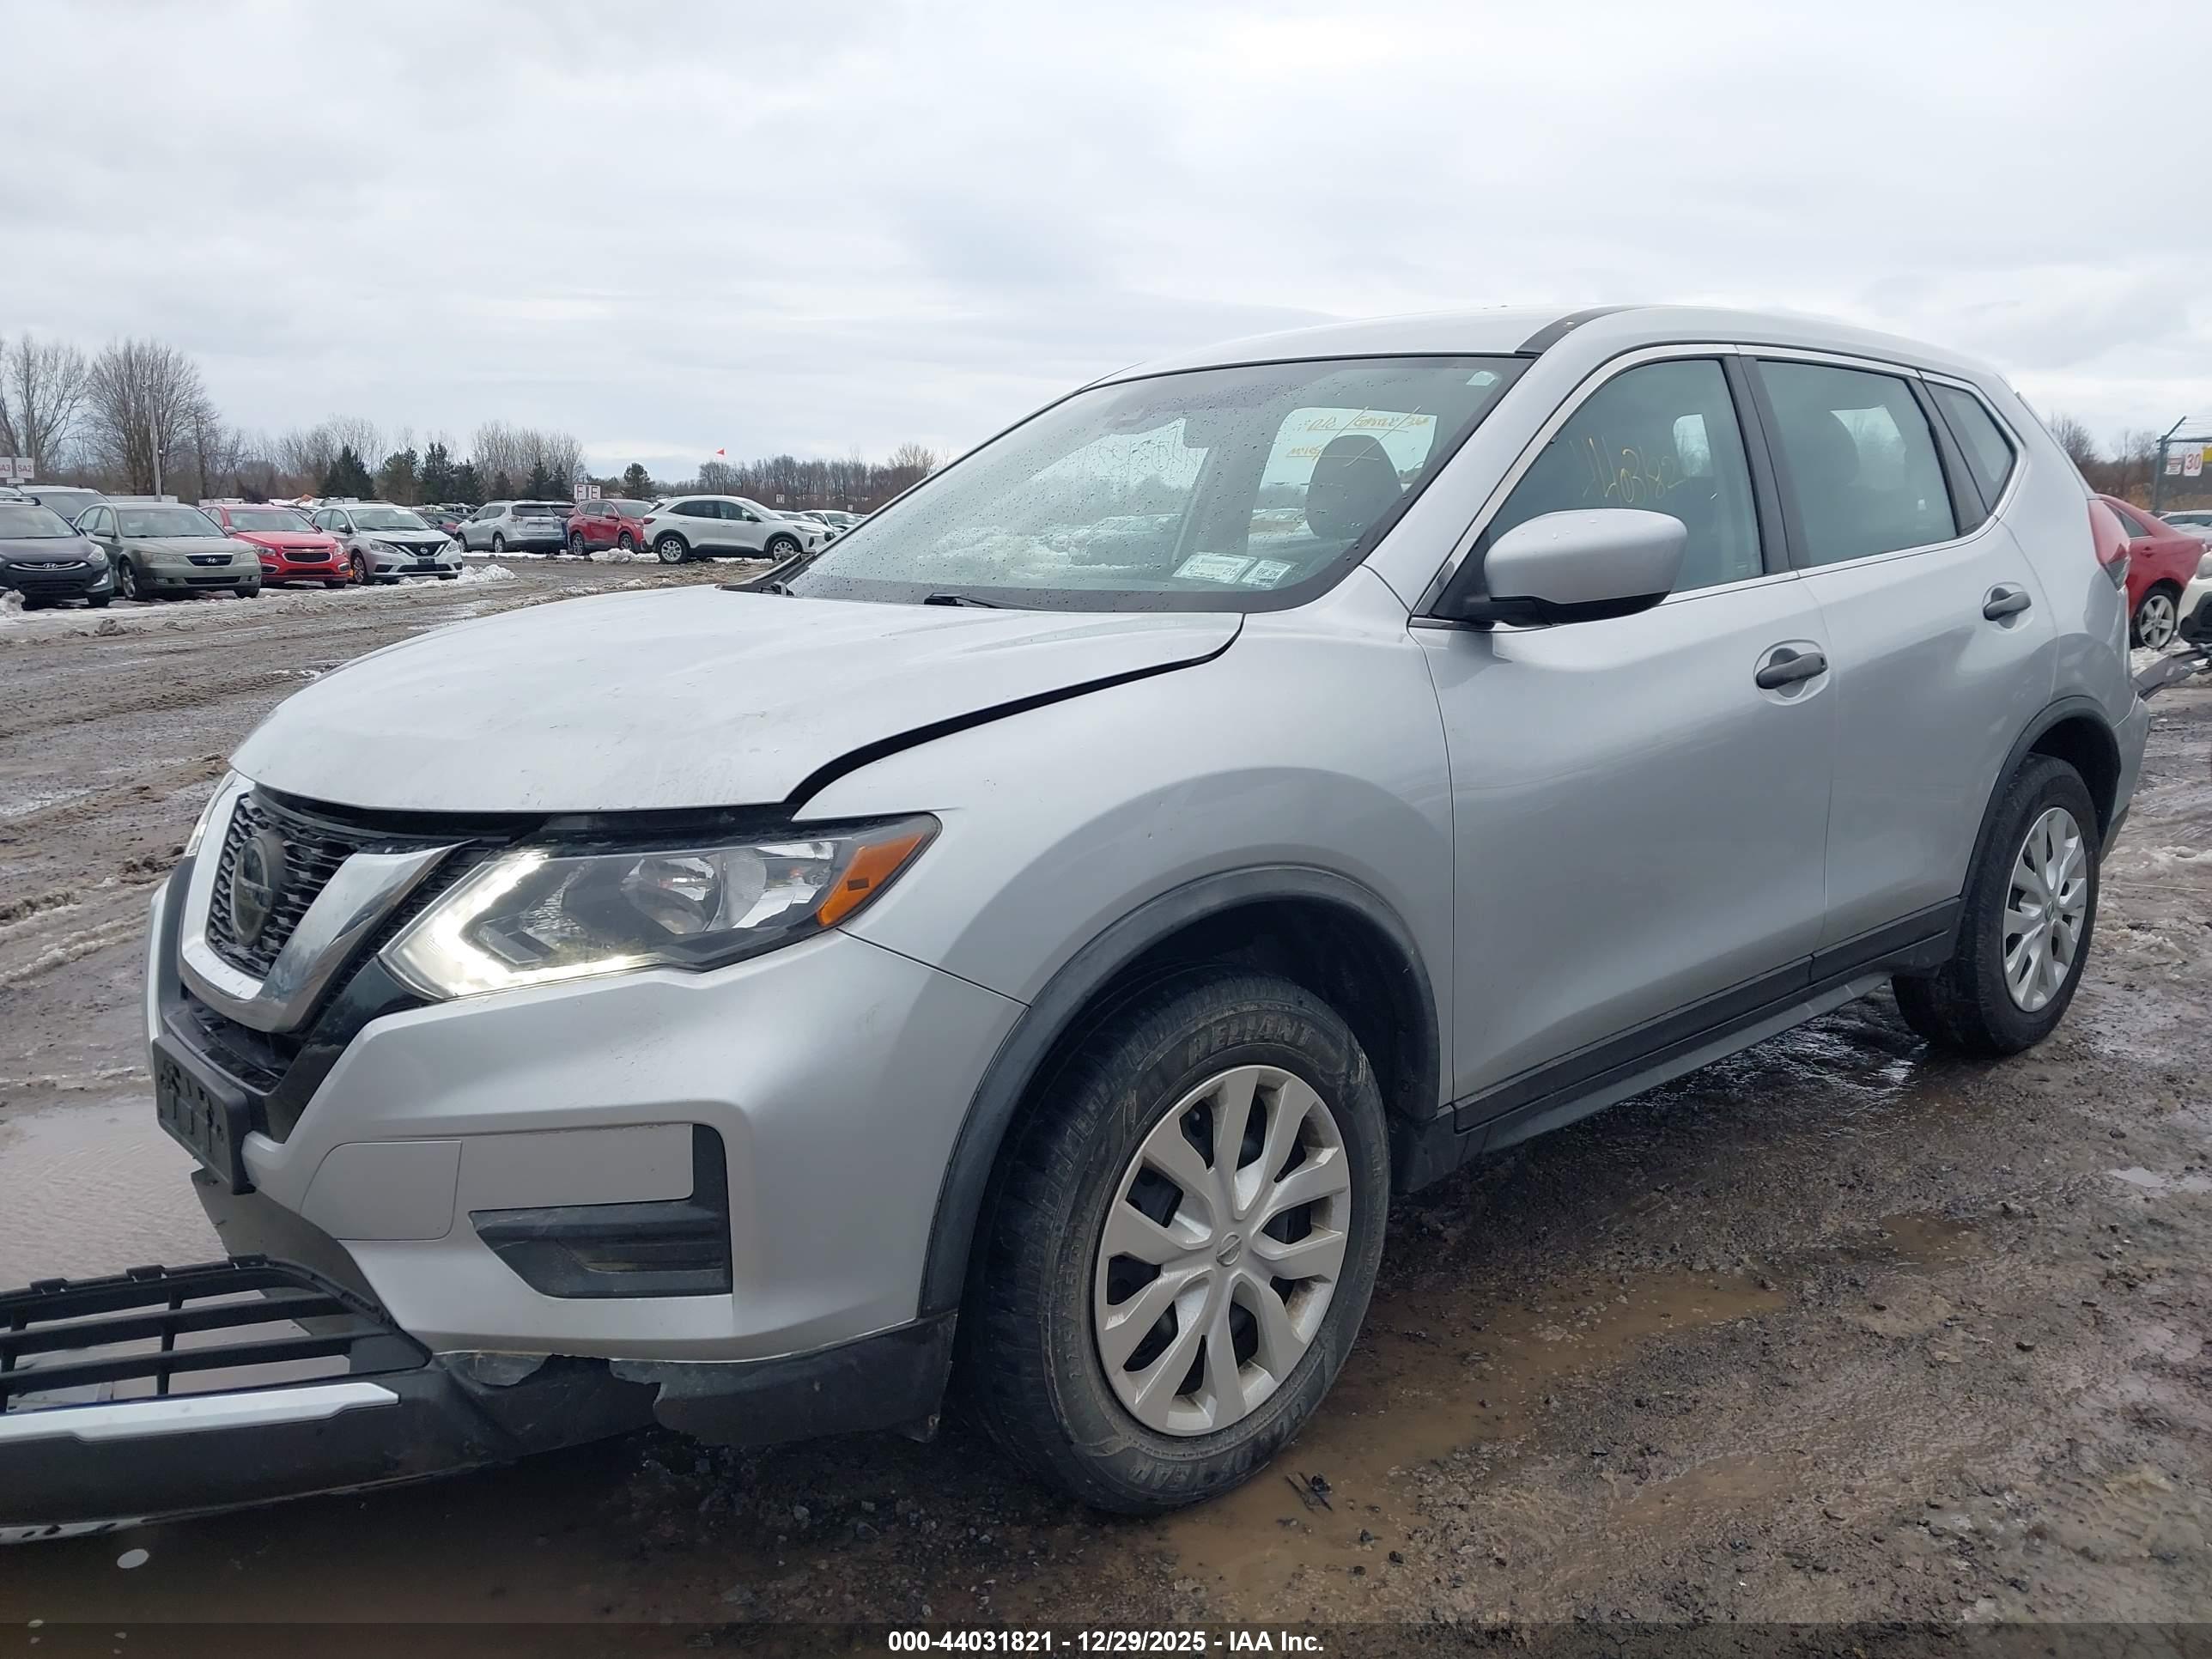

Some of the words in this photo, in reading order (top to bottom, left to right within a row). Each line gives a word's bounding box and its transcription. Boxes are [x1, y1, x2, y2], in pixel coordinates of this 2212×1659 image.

[0, 464, 10, 472] A3
[17, 464, 33, 472] SA2
[2186, 453, 2201, 470] 30
[576, 485, 584, 498] F
[591, 486, 599, 499] E
[1188, 1014, 1316, 1067] RELIANT
